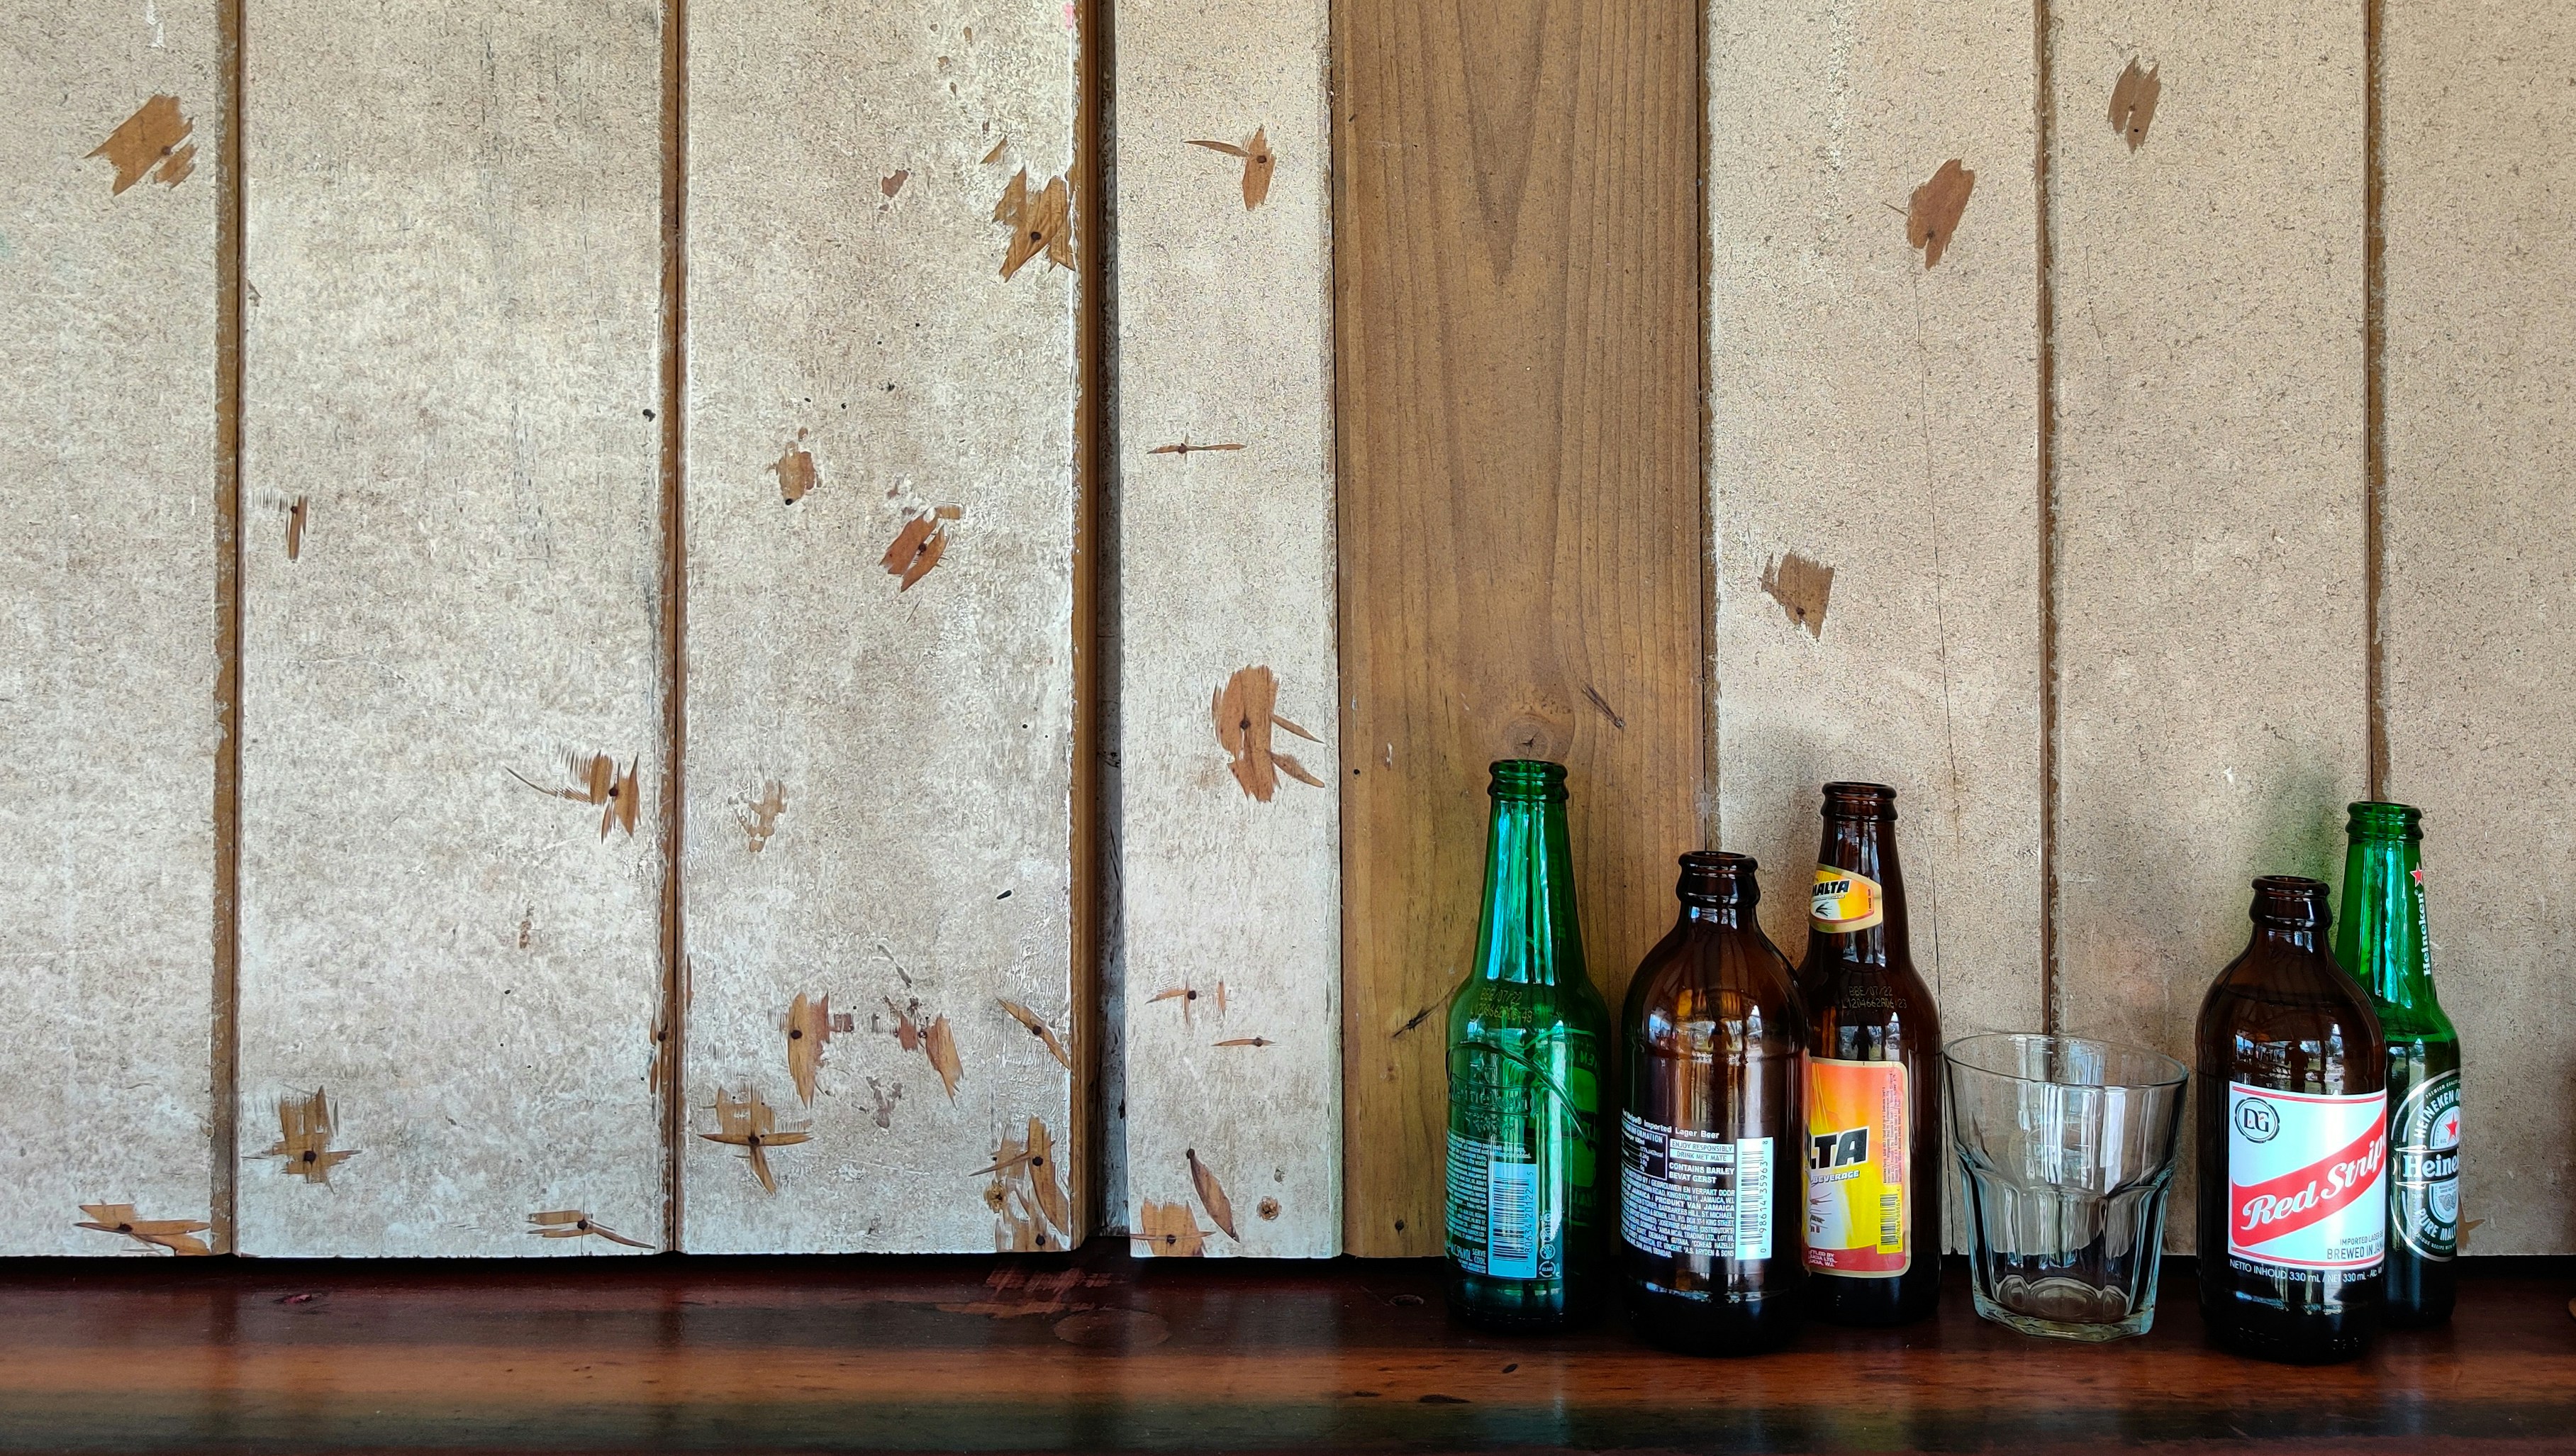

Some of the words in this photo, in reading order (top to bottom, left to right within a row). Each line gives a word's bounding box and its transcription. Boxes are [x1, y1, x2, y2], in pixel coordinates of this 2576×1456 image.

[2413, 1089, 2454, 1138] HEINEKEN
[1644, 1118, 1672, 1133] Imported
[1675, 1126, 1698, 1138] Lager
[1700, 1129, 1720, 1139] Beer
[1672, 1140, 1691, 1149] ENJOY
[1693, 1143, 1733, 1152] RESPONSIBLY
[1677, 1150, 1695, 1159] DRINK
[1696, 1152, 1710, 1161] MET
[1668, 1162, 1705, 1174] CONTAINS
[1706, 1166, 1735, 1175] BARLEY
[2402, 1153, 2458, 1178] Heine
[1668, 1171, 1692, 1182] BEVAT
[1693, 1174, 1717, 1184] GERST
[1760, 1161, 1768, 1194] 35963
[2240, 1179, 2320, 1231] Red
[2320, 1134, 2384, 1200] Strip
[1666, 1191, 1692, 1202] KINGSTON
[1683, 1185, 1691, 1194] EN
[1692, 1187, 1717, 1196] VERPAKT
[1524, 1189, 1534, 1218] 20122
[1655, 1195, 1685, 1208] PRODUKT
[1687, 1201, 1702, 1210] VAN
[1703, 1204, 1735, 1212] JAMAICA
[1759, 1200, 1768, 1233] 98614
[2414, 1207, 2439, 1238] PURE
[1524, 1223, 1533, 1253] 80634
[2340, 1236, 2368, 1245] IMPORTED
[2327, 1247, 2365, 1260] BREWED
[2366, 1245, 2373, 1257] IN
[2229, 1258, 2252, 1273] NETTO
[2253, 1265, 2287, 1280] INHOUD
[2289, 1272, 2305, 1282] 330
[2342, 1273, 2356, 1282] 330
